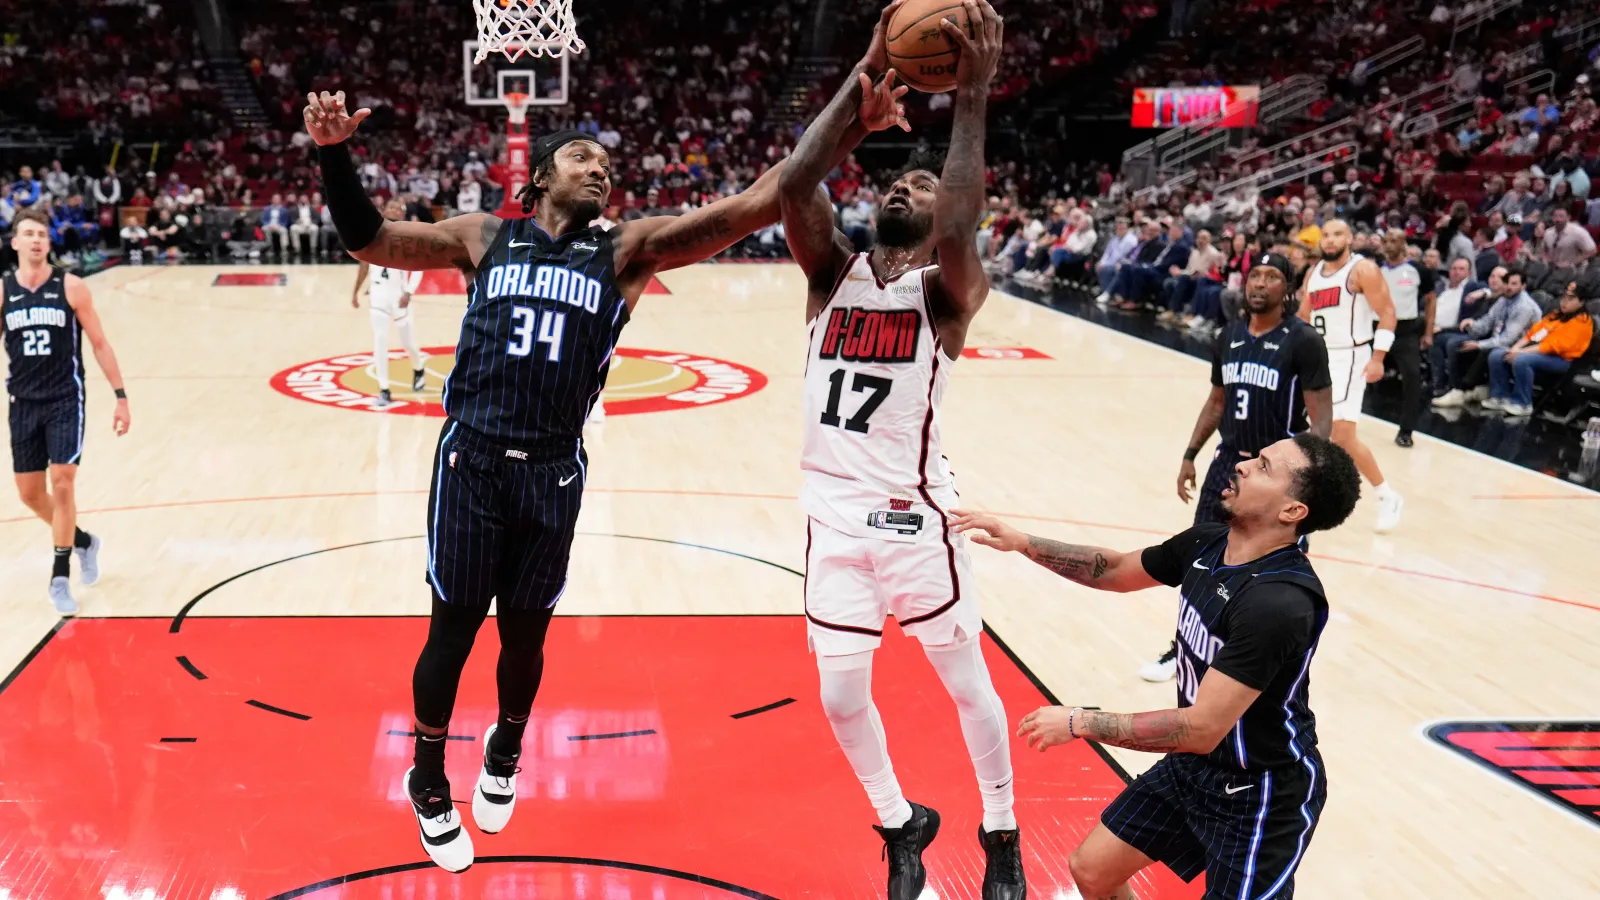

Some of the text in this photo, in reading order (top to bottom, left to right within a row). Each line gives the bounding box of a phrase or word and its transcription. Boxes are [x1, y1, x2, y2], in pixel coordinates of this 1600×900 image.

[487, 263, 602, 315] ORLANDO
[5, 306, 66, 331] ORLANDO
[507, 305, 567, 362] 34
[820, 307, 921, 363] H-TOWN
[1314, 315, 1326, 336] 9
[22, 329, 51, 356] 22
[1221, 361, 1279, 391] ORLANDO
[820, 368, 893, 434] 17
[1235, 389, 1249, 420] 3
[505, 449, 528, 460] MAGIC
[1178, 593, 1225, 666] LANDO
[1177, 640, 1199, 705] 50
